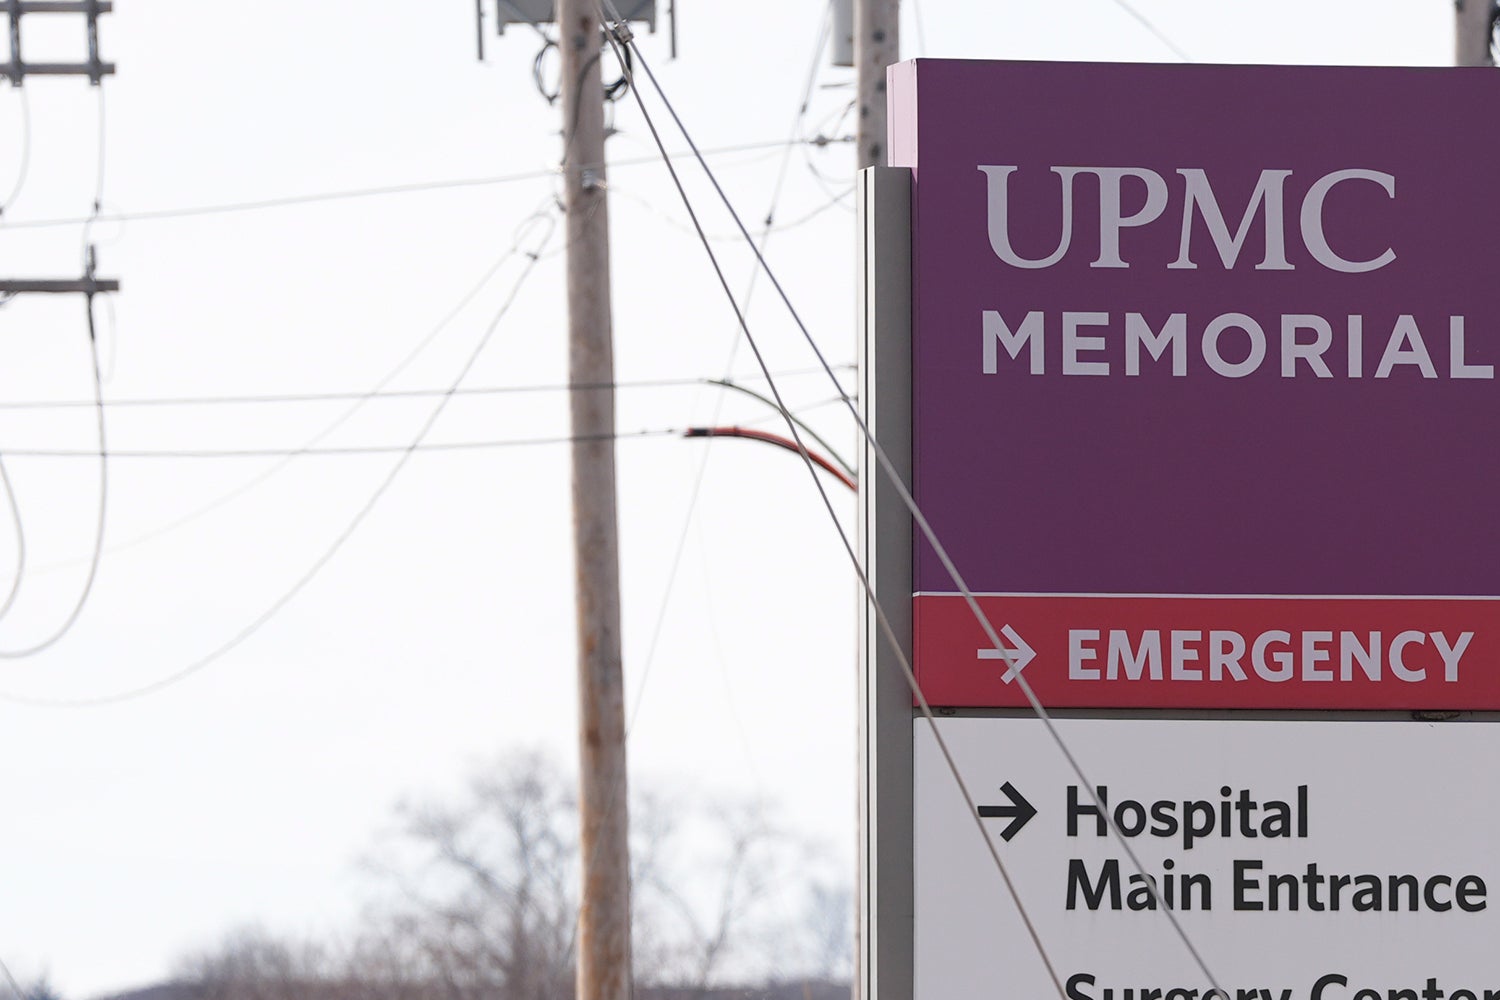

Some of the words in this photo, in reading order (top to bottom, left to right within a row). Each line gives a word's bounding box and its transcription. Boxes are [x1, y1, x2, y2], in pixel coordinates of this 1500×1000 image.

[977, 165, 1396, 272] UPMC
[983, 311, 1493, 378] MEMORIAL
[1069, 630, 1473, 681] EMERGENCY
[1067, 785, 1307, 850] Hospital
[1066, 859, 1211, 910] Main
[1234, 860, 1486, 912] Entrance
